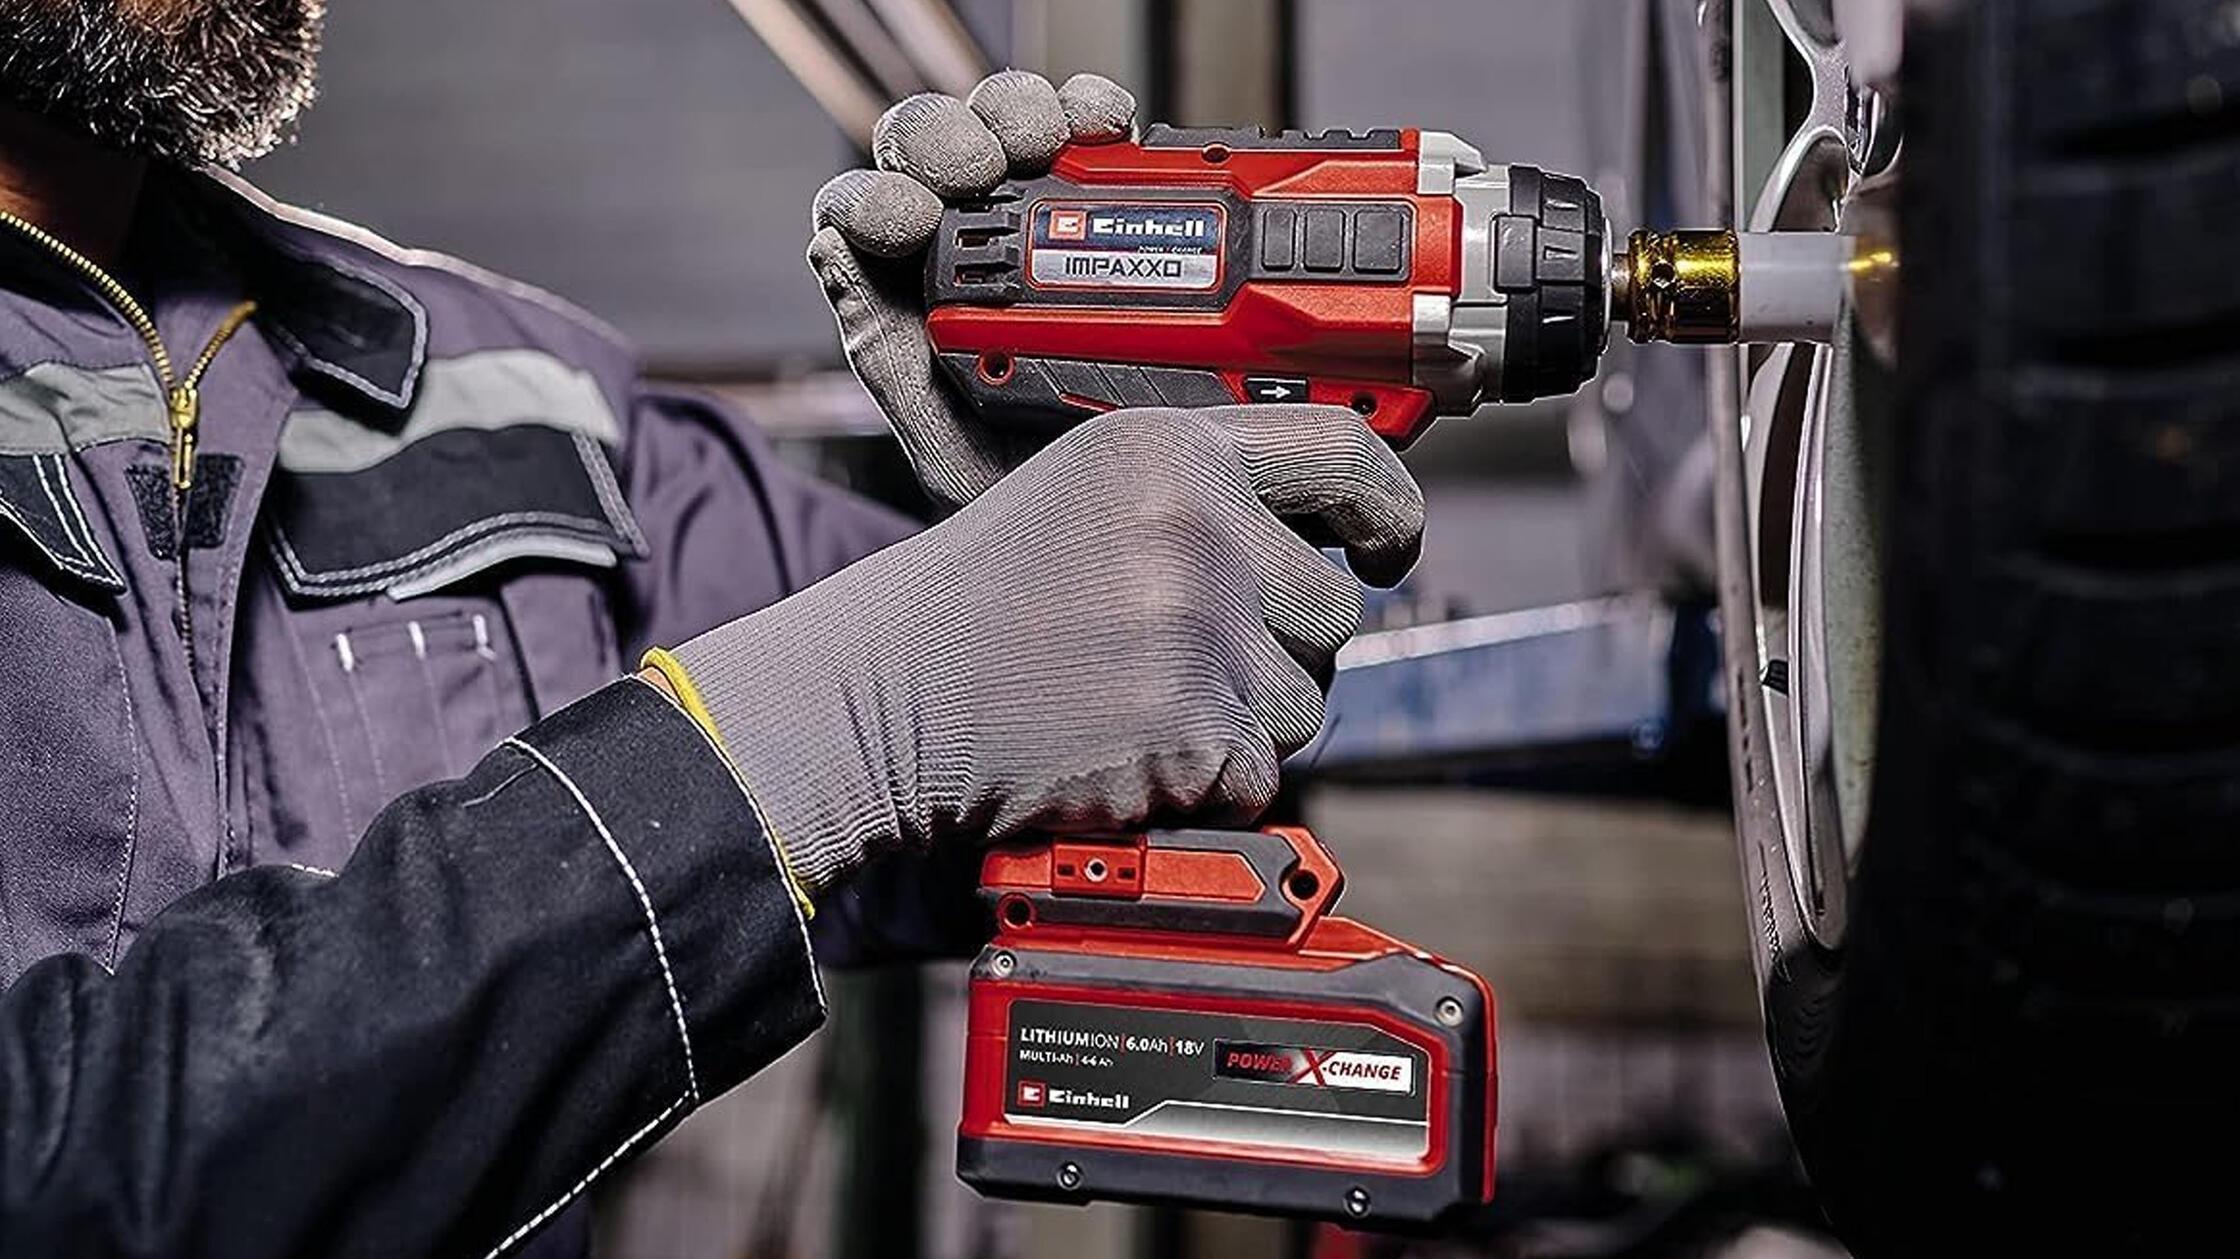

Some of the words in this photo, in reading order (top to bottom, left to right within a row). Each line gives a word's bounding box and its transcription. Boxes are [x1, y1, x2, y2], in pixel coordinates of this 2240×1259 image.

[1093, 217, 1204, 236] Einhell
[1065, 256, 1182, 278] IMPAXXO
[1020, 1028, 1120, 1050] LITHIUMION
[1125, 1036, 1168, 1053] 6.0Ah
[1175, 1040, 1205, 1056] 18V
[1225, 1051, 1293, 1073] POWER
[1048, 1089, 1129, 1109] Einhell
